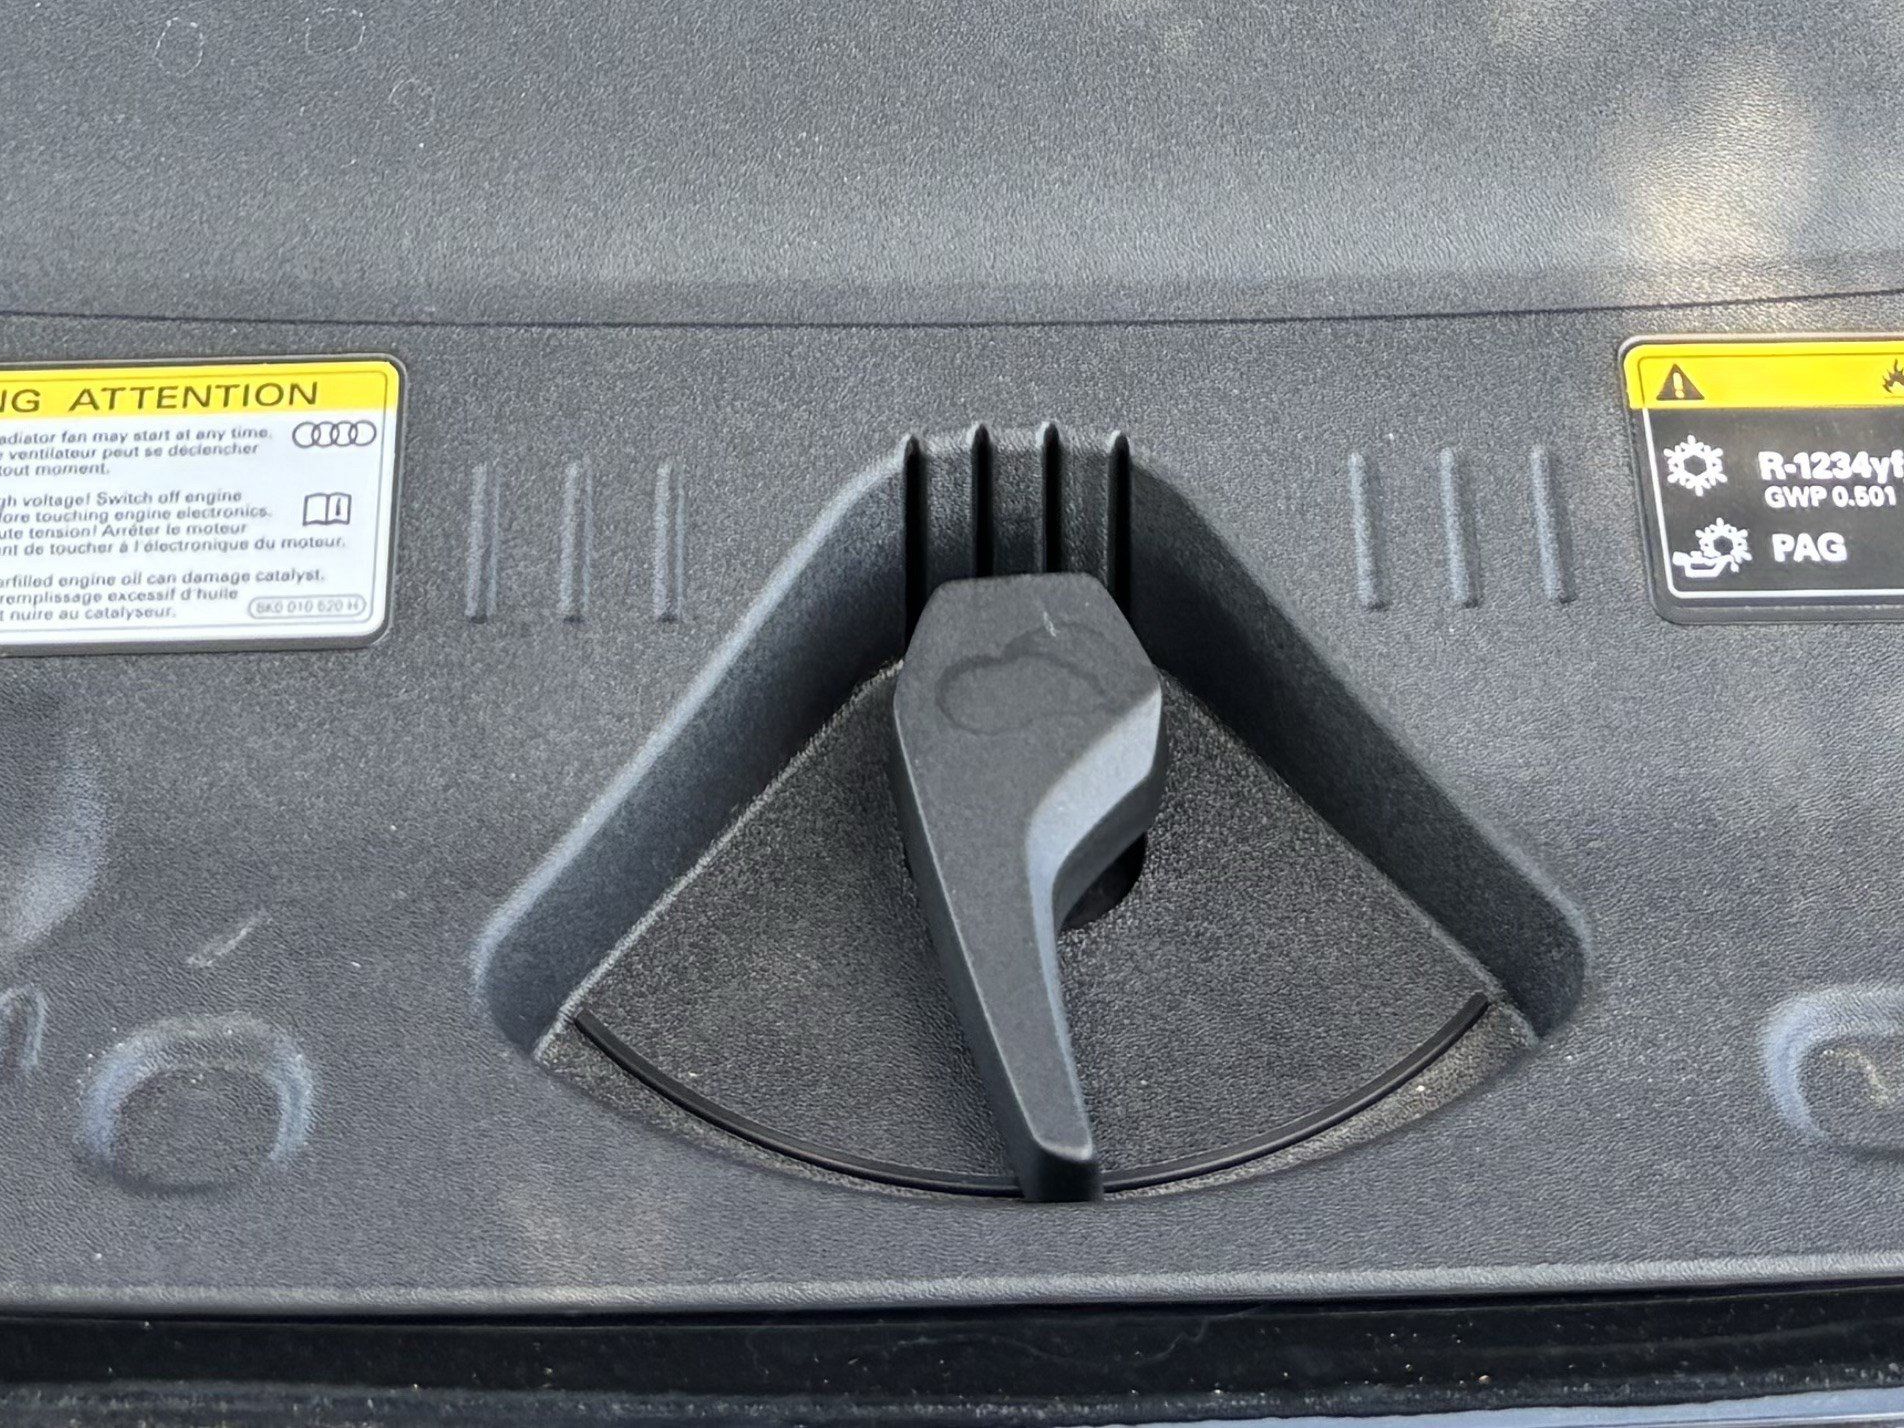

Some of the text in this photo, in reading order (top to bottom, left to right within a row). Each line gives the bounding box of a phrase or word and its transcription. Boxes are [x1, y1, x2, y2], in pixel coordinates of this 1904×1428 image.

[68, 381, 317, 411] ATTENTION
[61, 430, 87, 443] fan
[92, 433, 127, 444] may
[133, 430, 170, 441] start
[176, 429, 190, 440] at
[196, 430, 225, 441] any
[9, 447, 96, 460] ventilateur
[102, 446, 138, 460] peut
[144, 447, 162, 457] se
[23, 492, 90, 509] voltage!
[96, 491, 152, 506] Switch
[158, 490, 180, 504] off
[185, 492, 241, 505] engine
[1764, 485, 1827, 508] GWP
[36, 508, 108, 523] touching
[114, 510, 171, 522] engine
[29, 524, 97, 539] tension!
[166, 523, 180, 535] le
[186, 523, 246, 535] moteur
[24, 542, 43, 556] de
[50, 542, 112, 555] toucher
[254, 537, 275, 550] du
[1771, 532, 1847, 562] PAG
[58, 575, 116, 589] engine
[121, 572, 141, 585] oil
[146, 573, 176, 588] can
[181, 571, 250, 585] damage
[0, 591, 102, 606] remplissage
[107, 588, 175, 601] excessif
[10, 607, 53, 621] nuire
[58, 610, 78, 620] au
